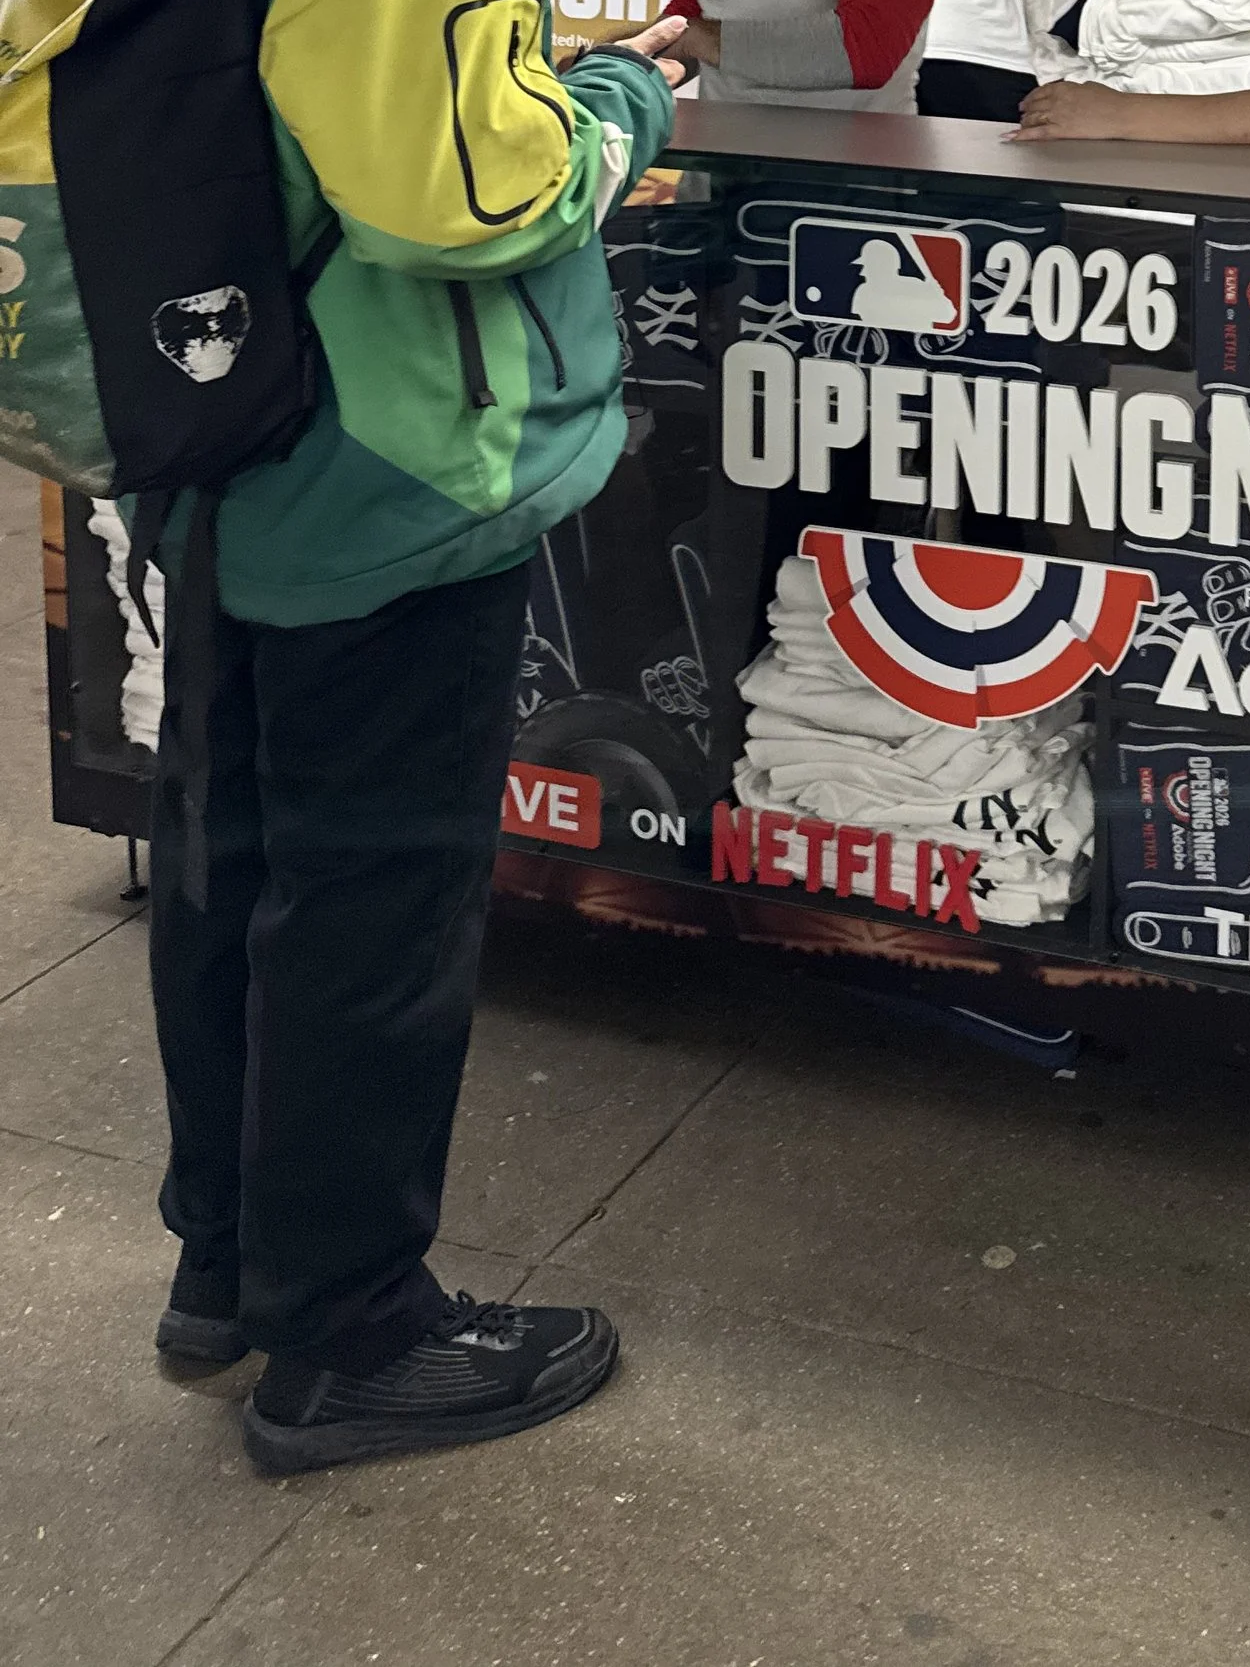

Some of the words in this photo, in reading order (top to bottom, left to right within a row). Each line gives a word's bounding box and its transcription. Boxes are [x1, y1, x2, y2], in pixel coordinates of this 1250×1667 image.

[984, 239, 1179, 352] 2026
[1223, 323, 1237, 373] NETFLIX
[721, 340, 1196, 540] OPENING
[1188, 756, 1214, 830] OPENING
[630, 807, 687, 847] ON
[711, 800, 982, 934] NETFLIX
[1171, 823, 1188, 871] Adobe
[1193, 831, 1217, 882] NIGHT
